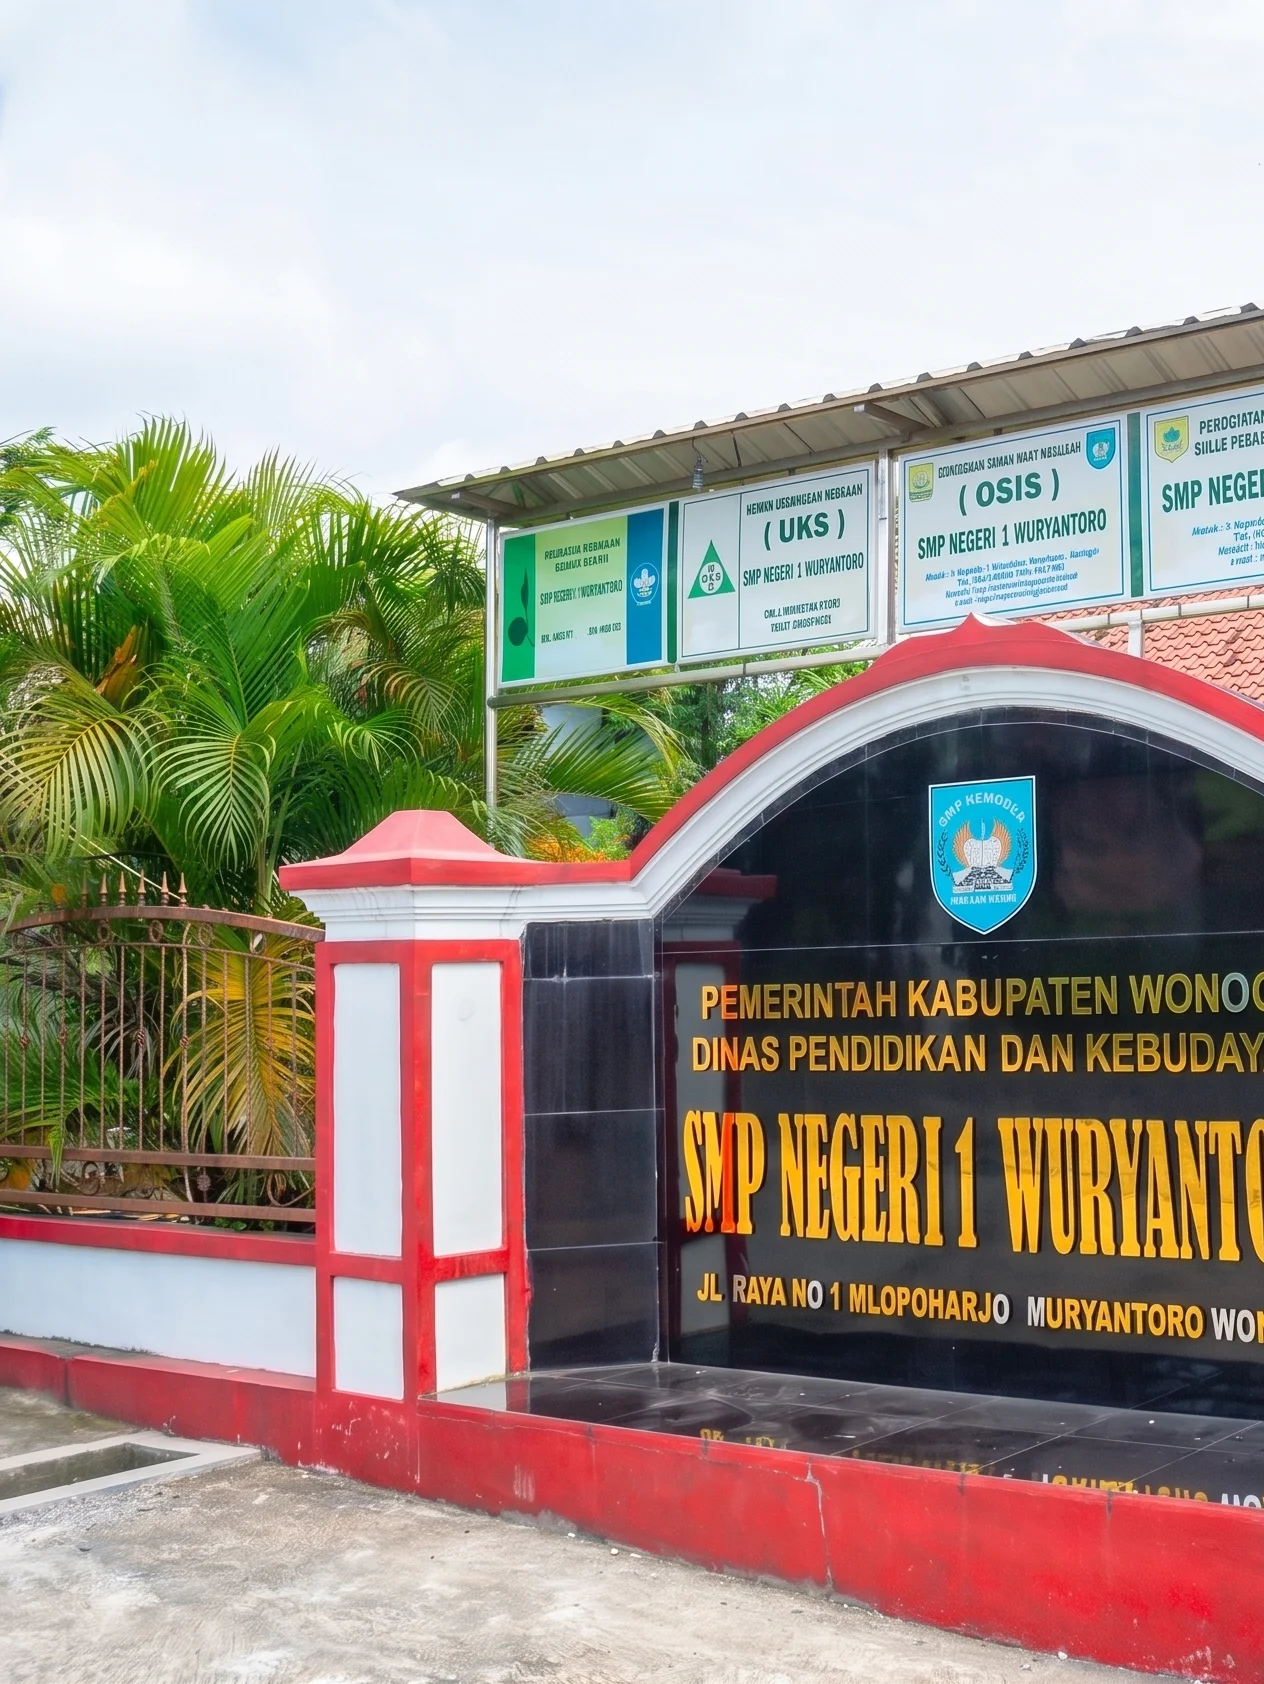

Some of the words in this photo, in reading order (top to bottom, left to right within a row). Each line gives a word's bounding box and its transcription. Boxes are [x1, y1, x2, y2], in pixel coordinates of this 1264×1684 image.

[975, 471, 1042, 508] OSIS
[1161, 479, 1202, 513] SMP
[779, 512, 829, 544] UKS
[917, 534, 946, 560] SMP
[949, 526, 996, 555] NEGERI
[1001, 524, 1010, 547] 1
[1014, 508, 1107, 545] WURYANTORO
[743, 568, 762, 587] SMP
[763, 562, 794, 585] NEGERI
[797, 562, 802, 579] 1
[804, 552, 864, 577] WURYANTORO
[702, 980, 897, 1020] PEMERINTAH
[908, 975, 1118, 1017] KABUPATEN
[692, 1035, 780, 1072] DINAS
[789, 1033, 986, 1072] PENDIDIKAN
[1001, 1033, 1074, 1073] DAN
[683, 1109, 765, 1235] SMP
[778, 1112, 945, 1247] NEGERI
[954, 1116, 977, 1248] 1
[697, 1273, 723, 1302] JL
[732, 1274, 787, 1306] RAYA
[792, 1278, 824, 1310] NO
[829, 1281, 840, 1311] 1
[849, 1283, 1010, 1325] MLOPOHARJO
[1027, 1296, 1204, 1339] MURYANTORO
